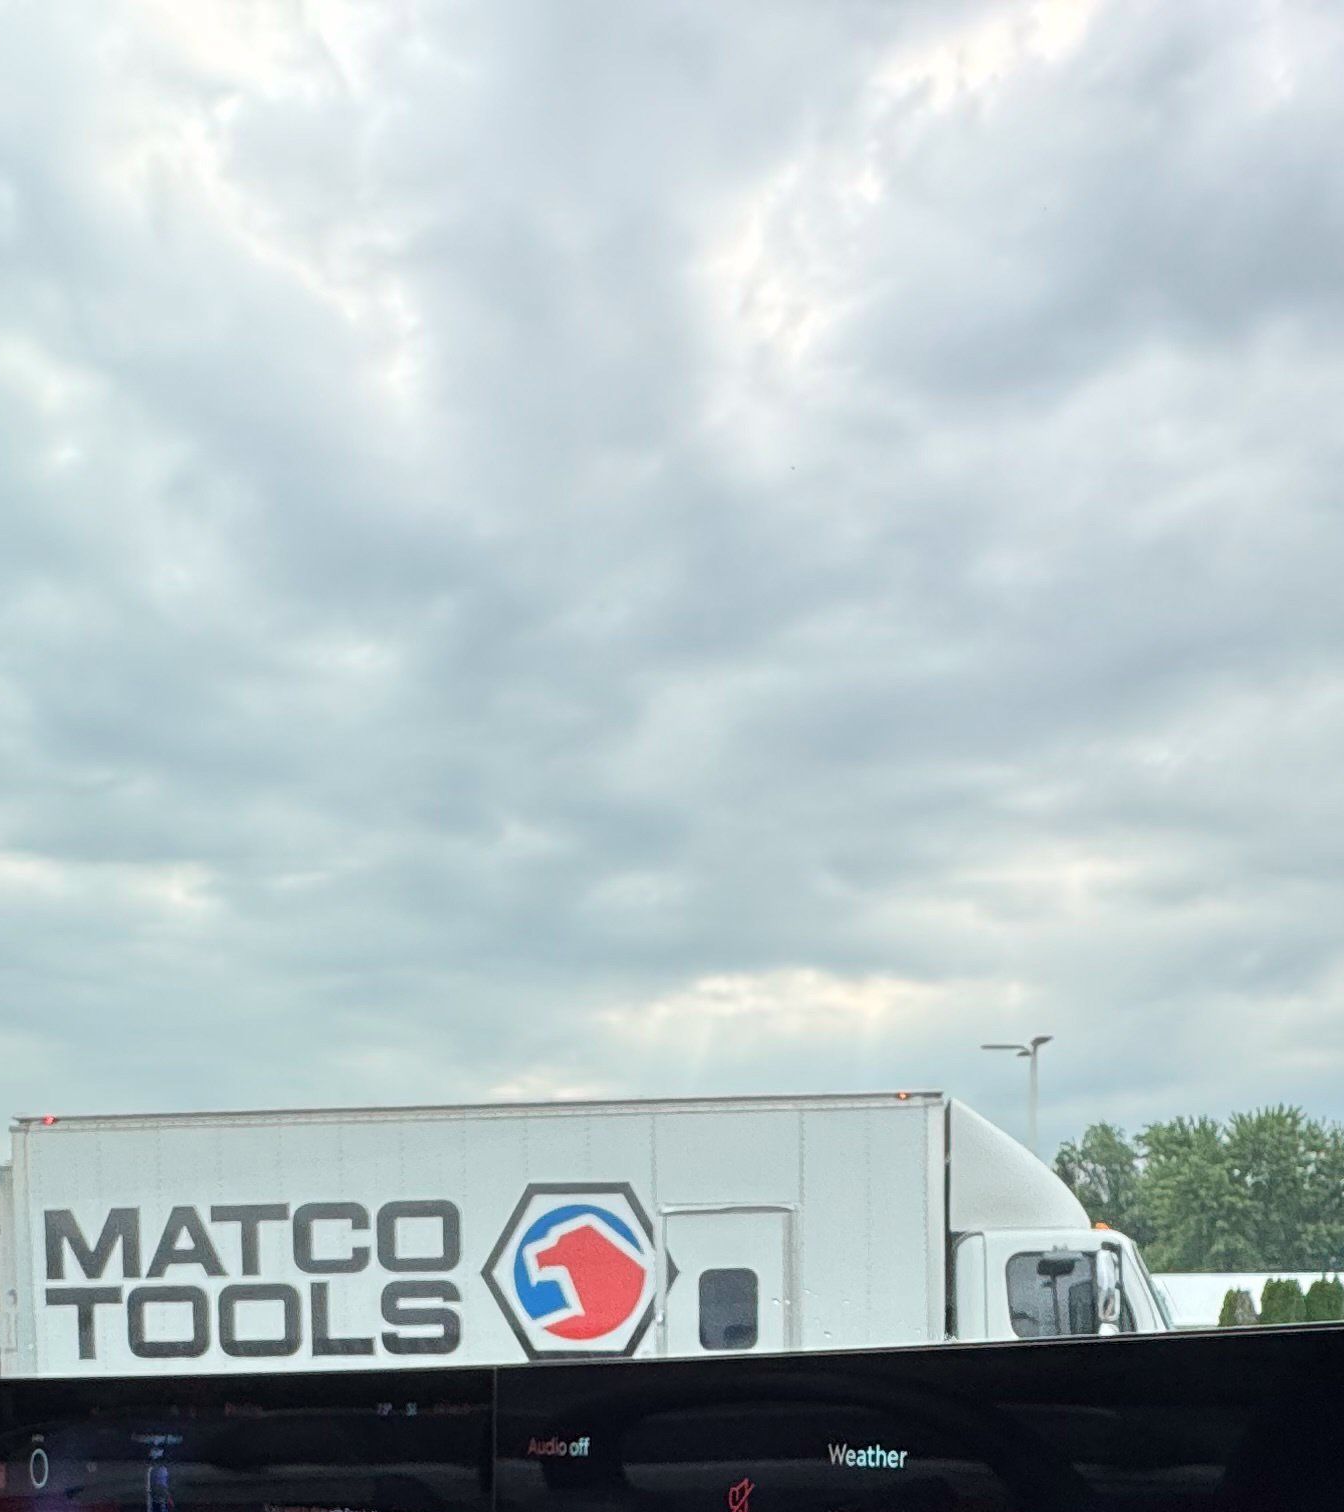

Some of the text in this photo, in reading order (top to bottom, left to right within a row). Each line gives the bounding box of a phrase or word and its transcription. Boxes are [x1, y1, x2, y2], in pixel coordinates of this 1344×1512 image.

[43, 1200, 459, 1280] MATCO
[45, 1279, 461, 1359] TOOLS
[528, 1436, 591, 1456] Audio off
[827, 1443, 908, 1468] Weather
